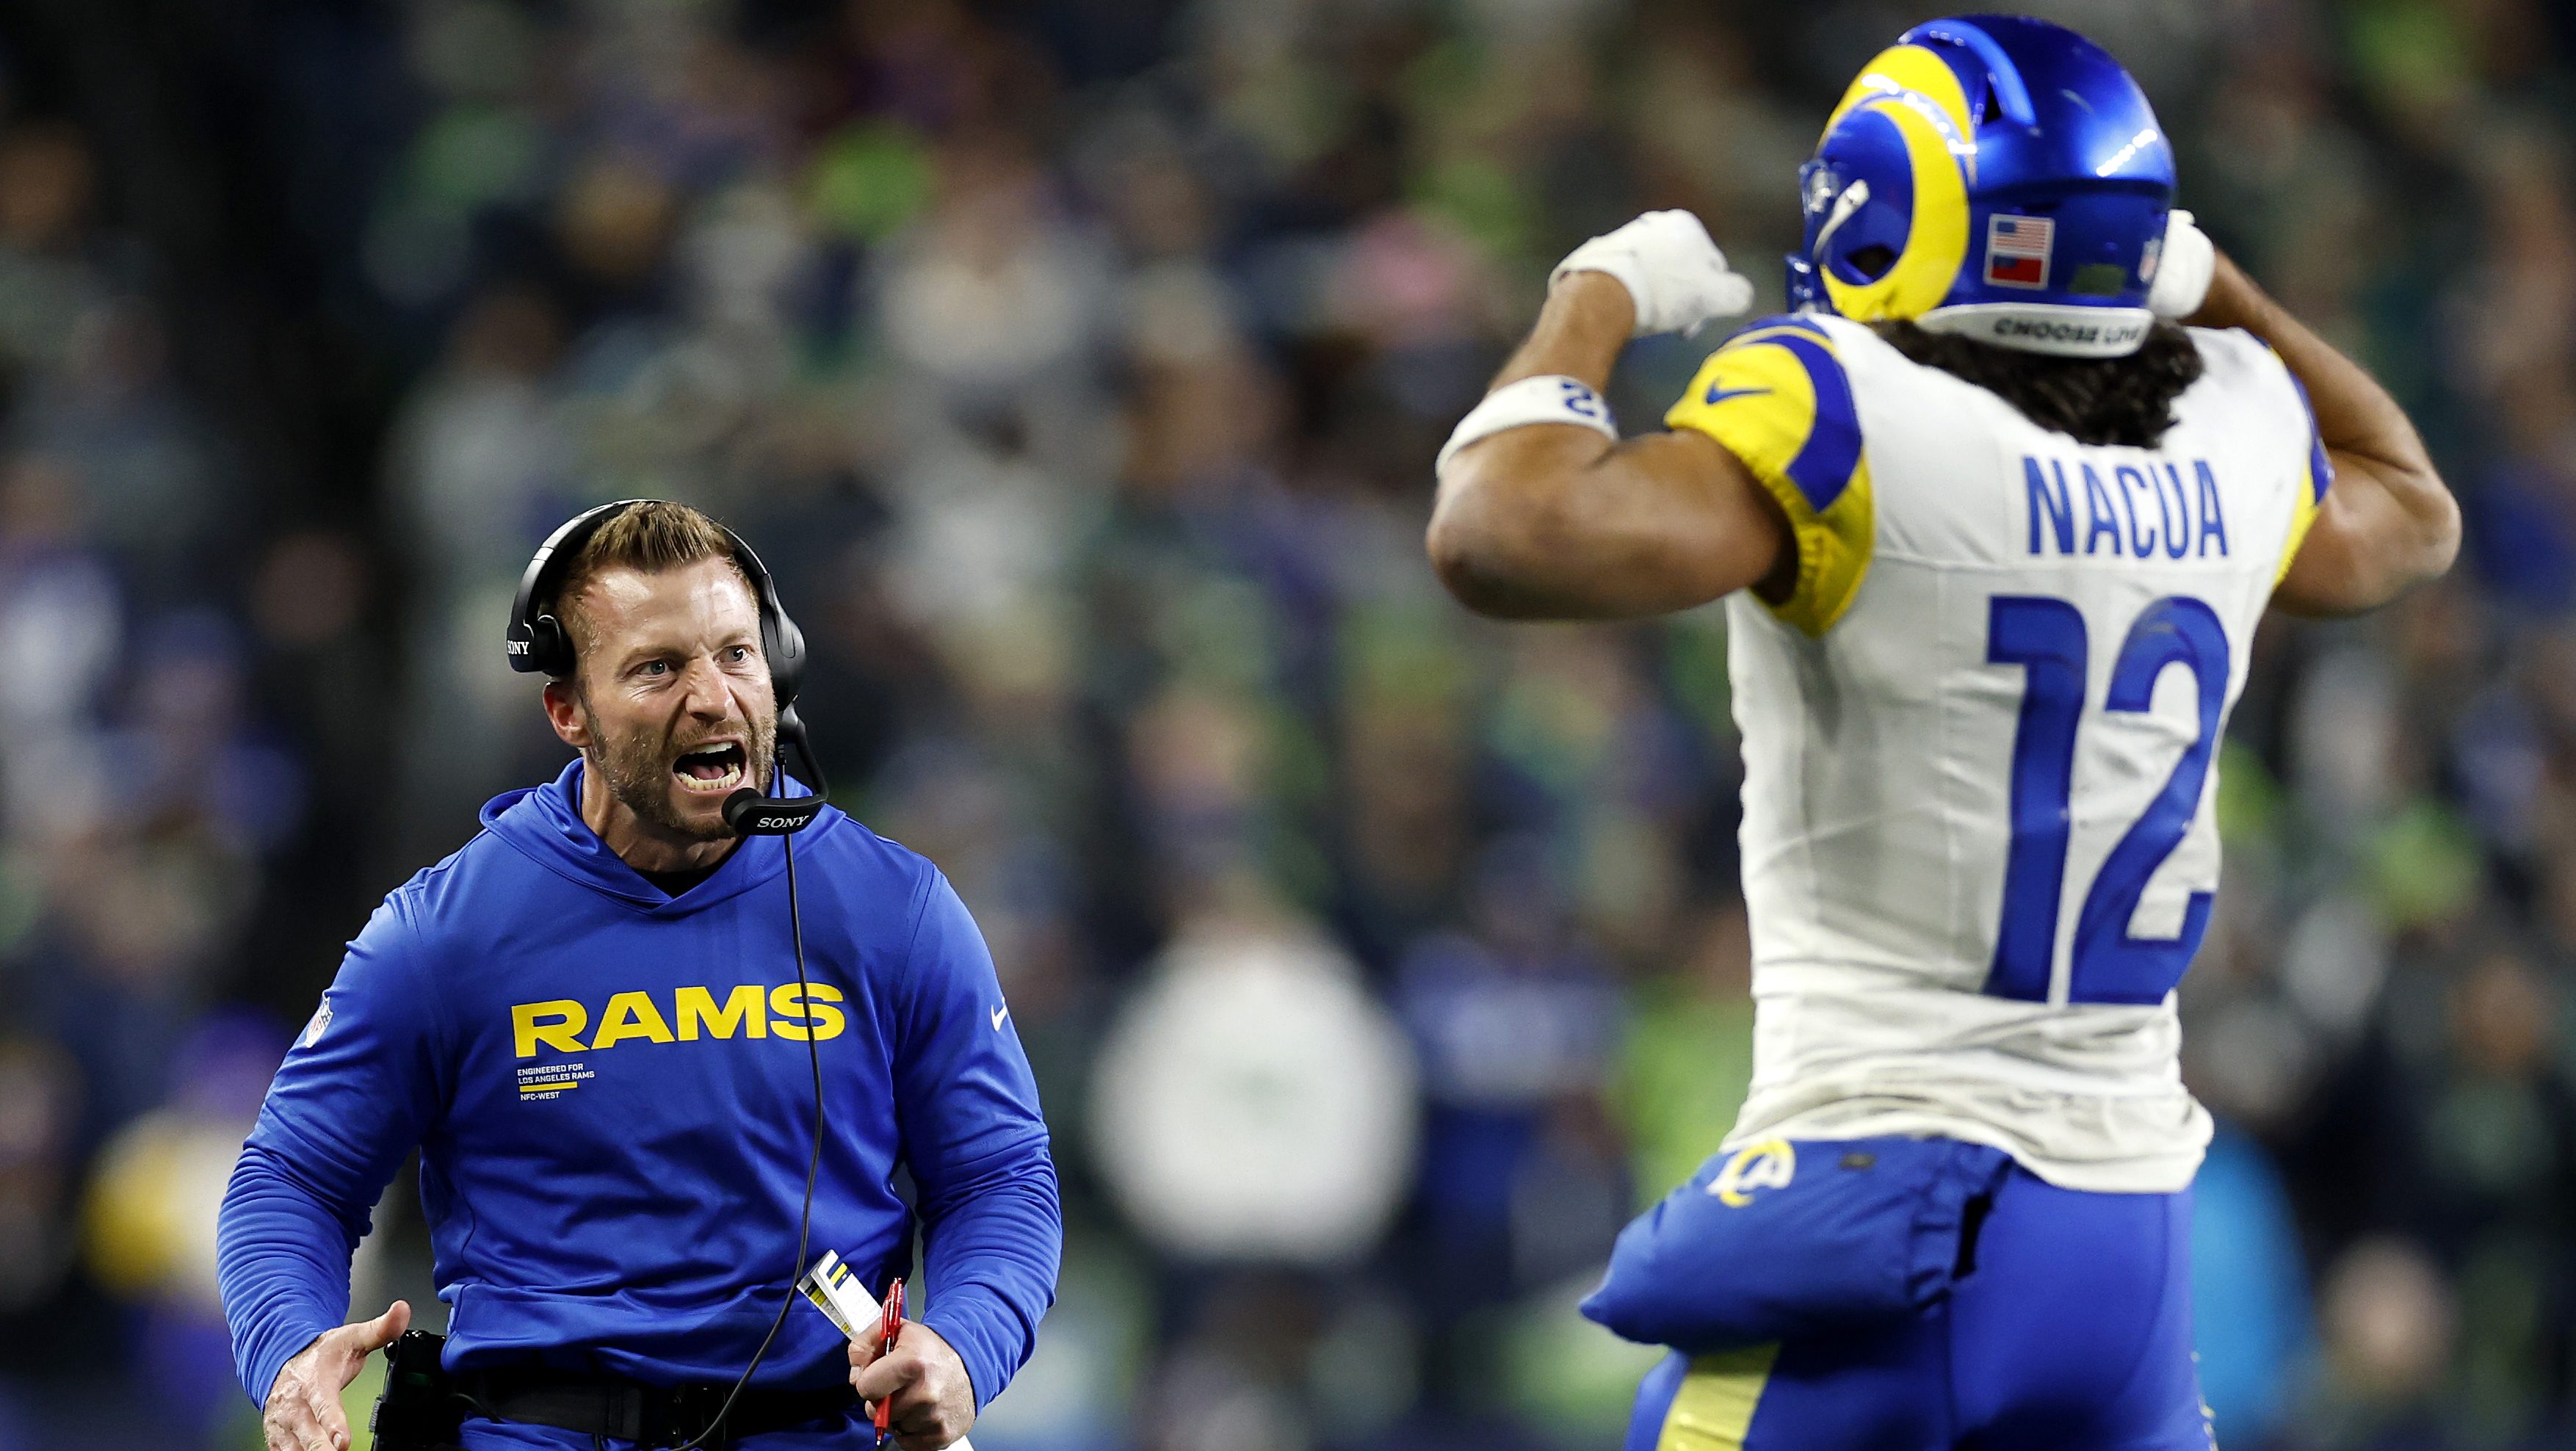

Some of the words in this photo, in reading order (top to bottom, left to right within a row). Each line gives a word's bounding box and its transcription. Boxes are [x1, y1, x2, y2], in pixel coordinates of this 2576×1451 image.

[2022, 455, 2228, 560] NACUA
[1983, 595, 2230, 1006] 12
[756, 814, 810, 828] SONY
[512, 983, 845, 1057] RAMS
[517, 1064, 566, 1077] ENGINEERED
[568, 1063, 584, 1071] FOR
[518, 1077, 533, 1085] LOS
[535, 1073, 571, 1083] ANGELES
[572, 1071, 595, 1079] RAMS
[520, 1091, 560, 1101] NFC-WEST
